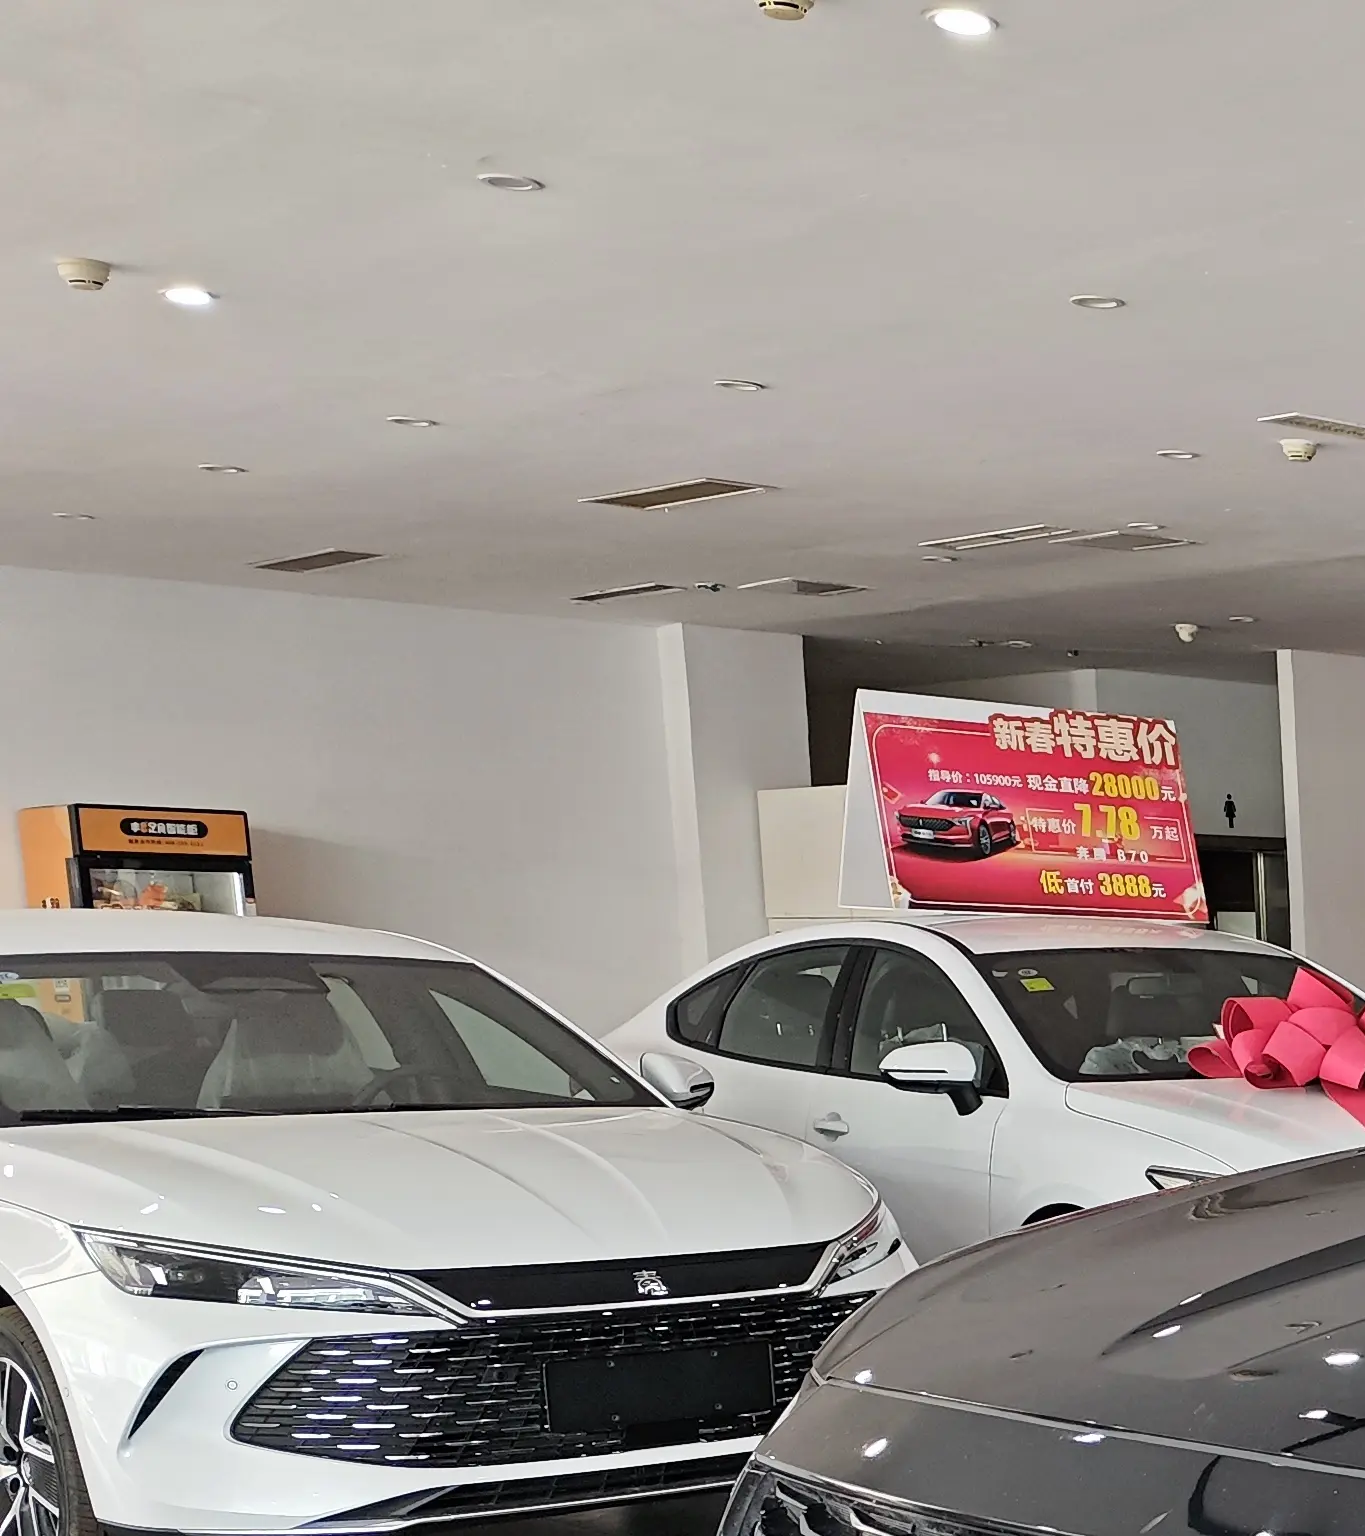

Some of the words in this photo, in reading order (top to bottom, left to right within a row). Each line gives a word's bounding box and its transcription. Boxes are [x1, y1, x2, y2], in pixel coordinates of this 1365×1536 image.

[992, 713, 1176, 767] 新春特惠价
[1027, 772, 1177, 801] 现金直降28000元
